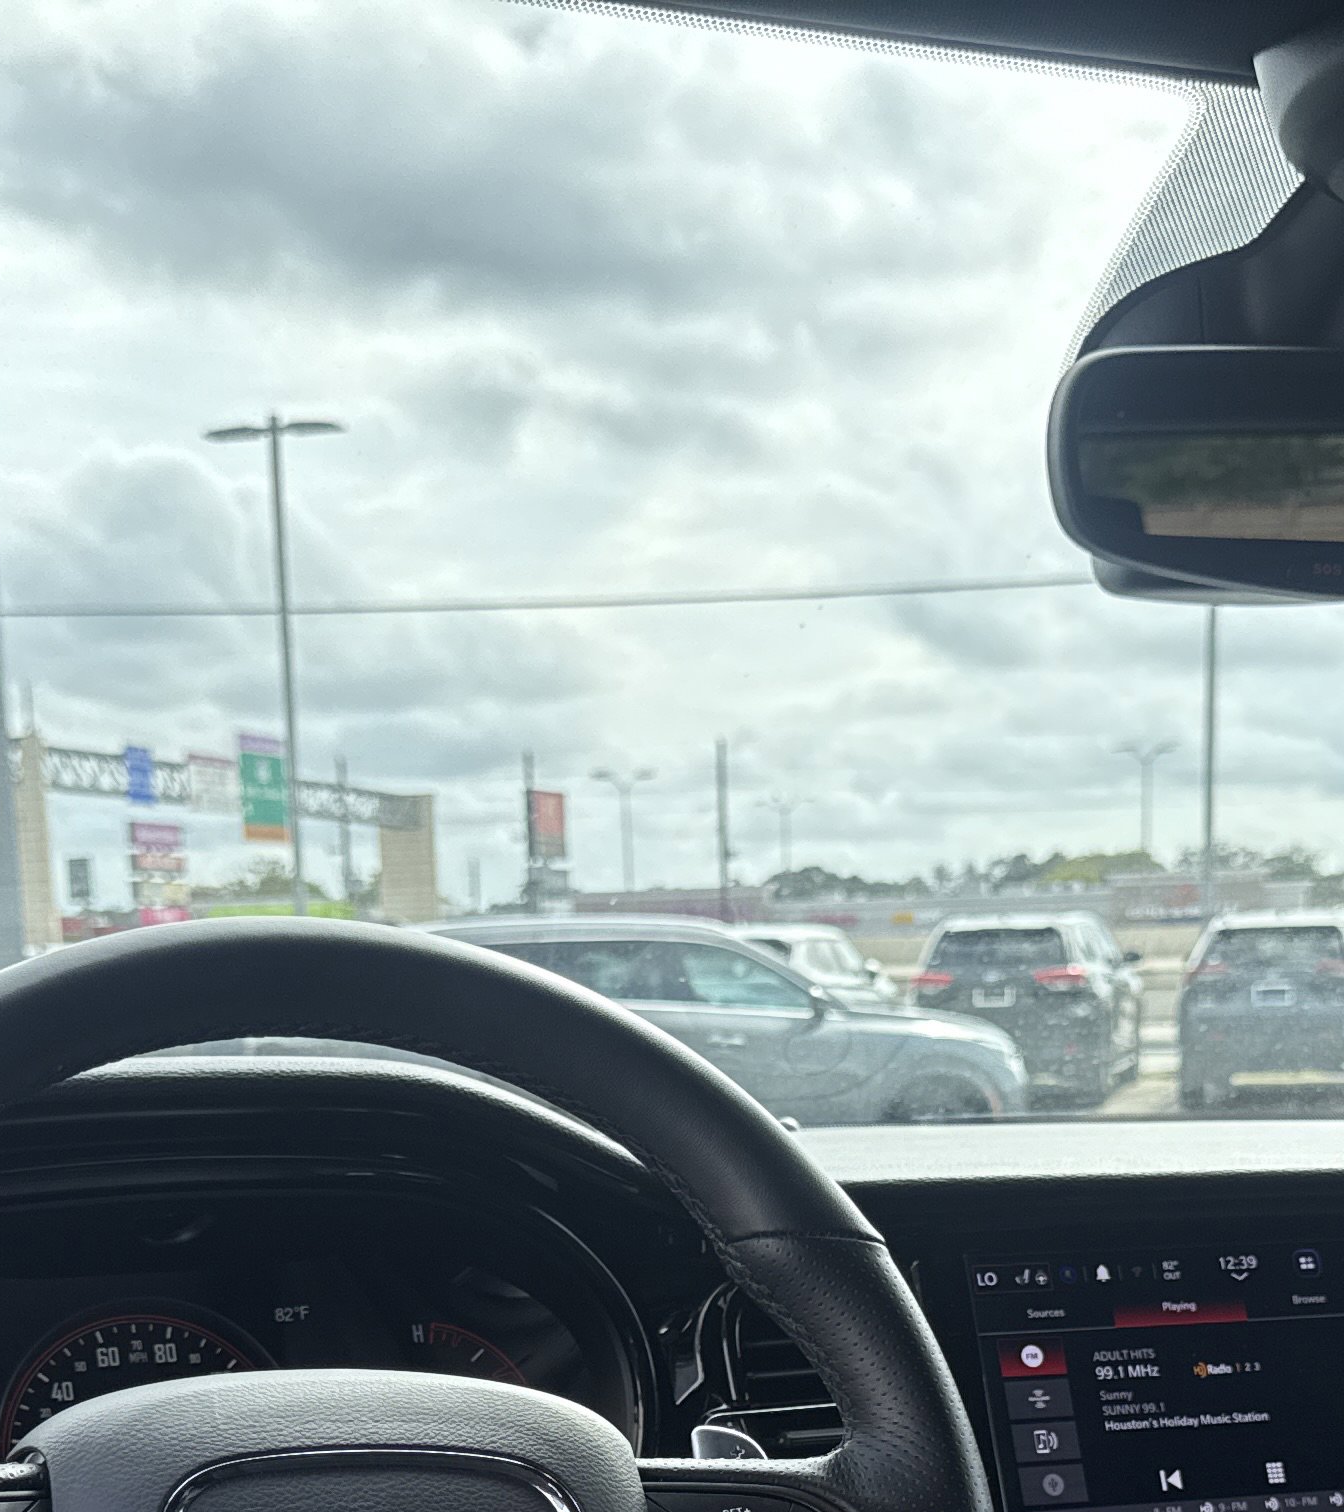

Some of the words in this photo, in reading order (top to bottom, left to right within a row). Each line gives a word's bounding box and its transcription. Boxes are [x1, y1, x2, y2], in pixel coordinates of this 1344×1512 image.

[1312, 563, 1342, 577] SOS
[1218, 1255, 1258, 1271] 12:39
[976, 1271, 998, 1287] LO
[1163, 1271, 1182, 1281] OUT
[1162, 1300, 1198, 1313] Playing
[1292, 1294, 1327, 1305] Browse
[274, 1306, 310, 1323] 82°F
[1026, 1307, 1066, 1319] Sources
[411, 1323, 425, 1344] H
[131, 1340, 144, 1351] 70
[96, 1347, 121, 1368] 60
[129, 1351, 148, 1363] MPH
[154, 1343, 177, 1364] 80
[1025, 1351, 1039, 1361] FM
[1093, 1350, 1130, 1362] ADULT
[1131, 1348, 1156, 1361] HITS
[1095, 1366, 1124, 1380] 99.1
[1128, 1364, 1161, 1379] MHz
[1207, 1363, 1233, 1375] Radio
[1245, 1362, 1252, 1372] 2
[51, 1382, 75, 1402] 40
[1099, 1389, 1133, 1402] Sunny
[1102, 1403, 1142, 1416] SUNNY
[1142, 1402, 1166, 1414] 99.1
[1104, 1418, 1158, 1432] Houston's
[1159, 1415, 1199, 1430] Holiday
[1200, 1413, 1231, 1425] Music
[1231, 1410, 1270, 1424] Station
